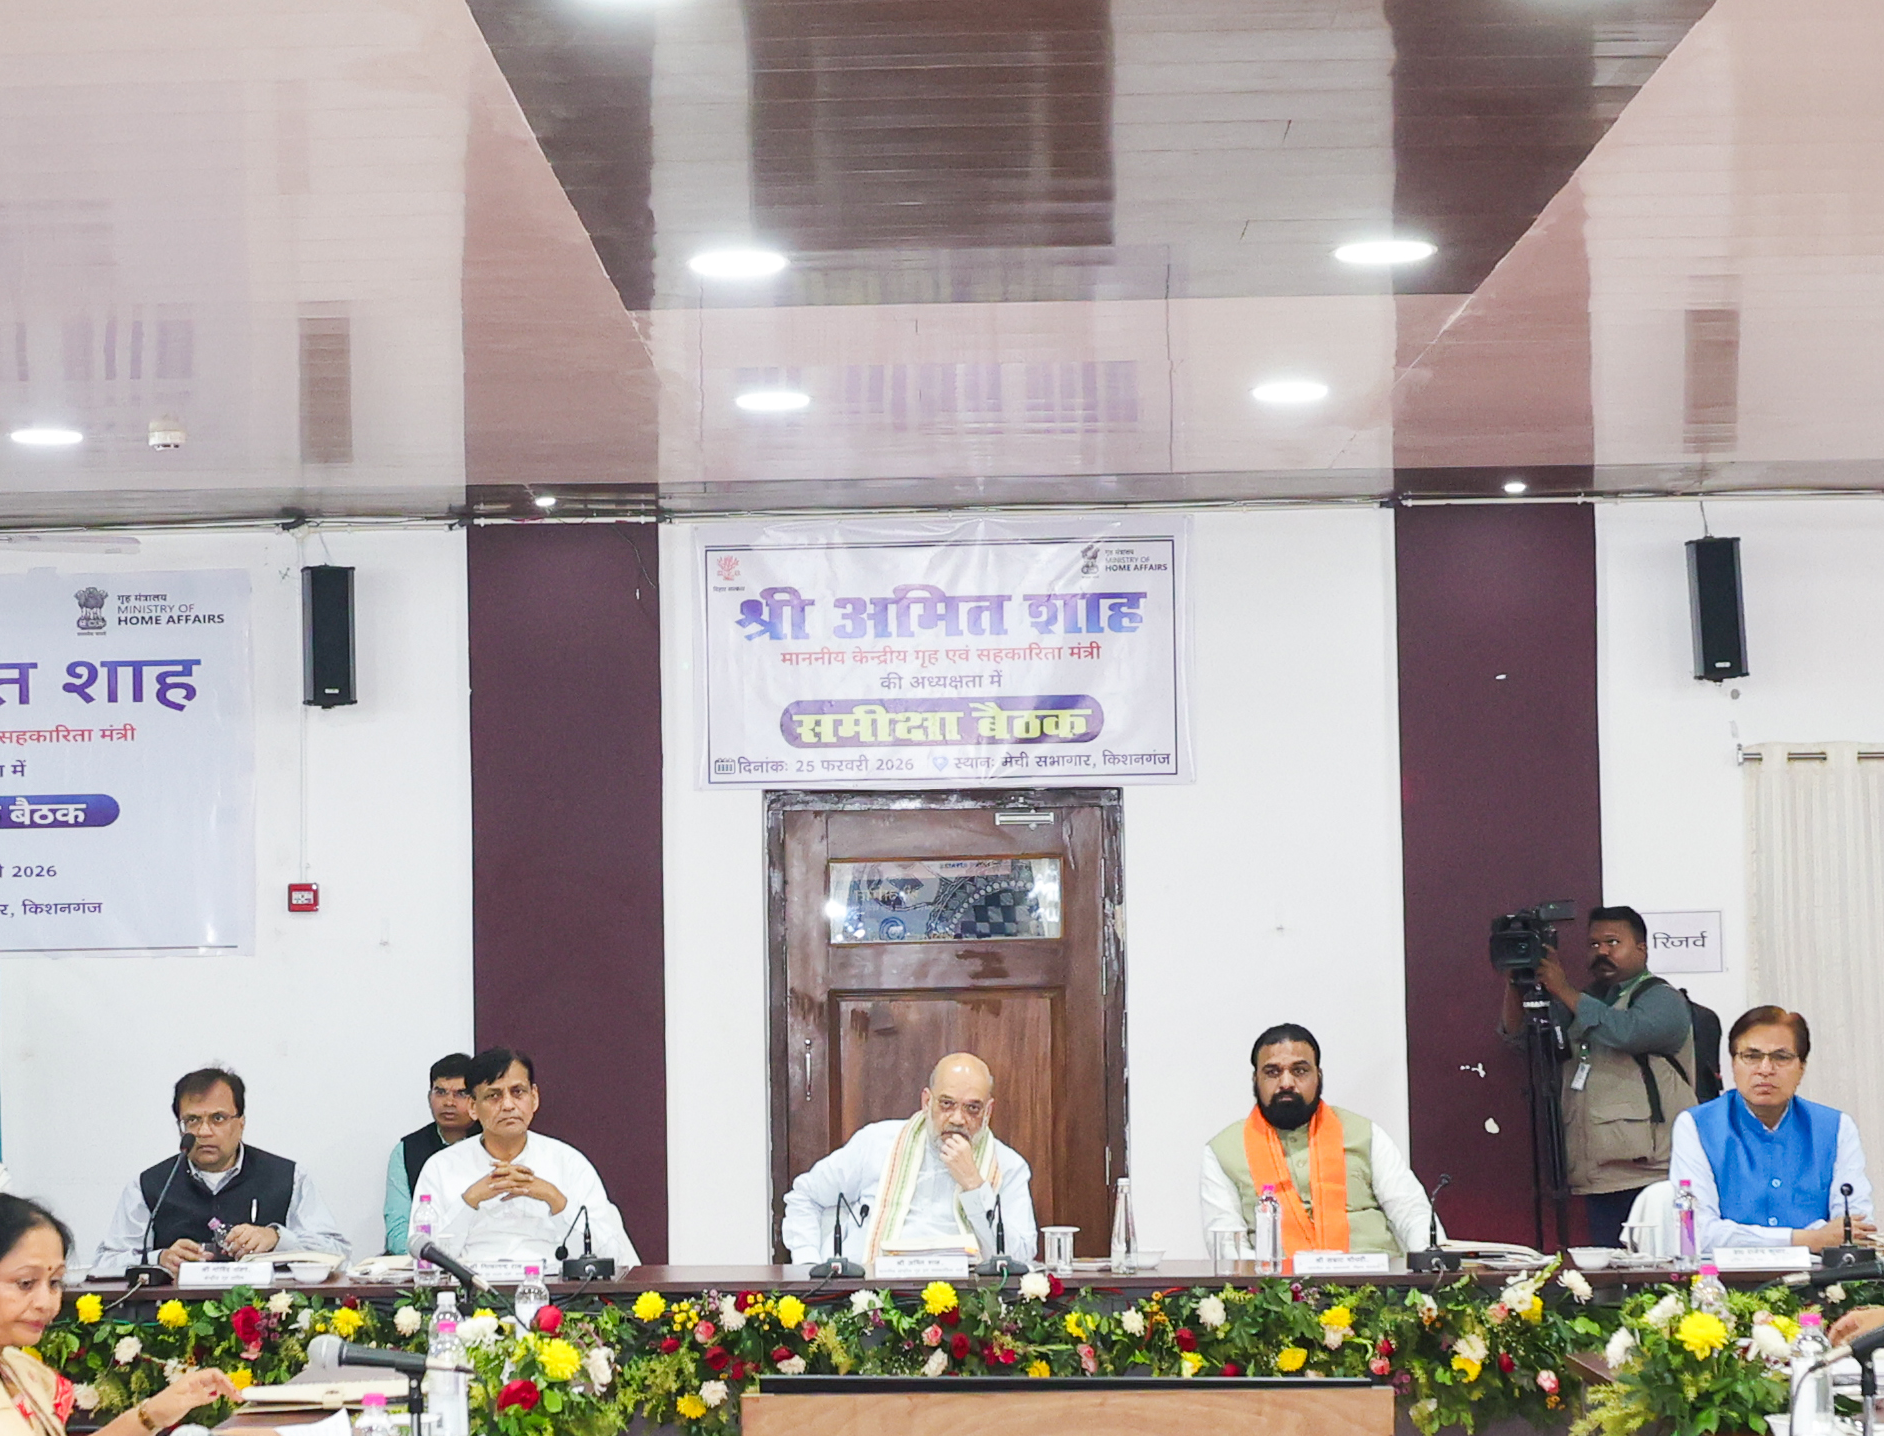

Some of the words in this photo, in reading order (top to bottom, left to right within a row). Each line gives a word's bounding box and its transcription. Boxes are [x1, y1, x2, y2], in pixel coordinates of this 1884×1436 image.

[1105, 564, 1131, 572] HOME
[1133, 563, 1168, 571] AFFAIRS
[118, 604, 174, 614] MINISTRY
[178, 603, 195, 613] OF
[735, 586, 815, 642] श्री
[833, 584, 1012, 640] अमित
[1023, 591, 1147, 634] शाह
[118, 616, 162, 626] HOME
[166, 614, 225, 625] AFFAIRS
[780, 646, 846, 666] माननीय
[852, 645, 908, 665] केन्द्रीय
[914, 650, 939, 668] गृह
[946, 646, 971, 664] एवं
[977, 643, 1063, 664] सहकारिता
[1069, 641, 1102, 660] मंत्री
[62, 659, 201, 712] शाह
[880, 672, 903, 690] की
[909, 674, 983, 690] अध्यक्षता
[989, 670, 1002, 688] में
[792, 704, 964, 743] समीक्षा
[969, 702, 1092, 740] बैठक
[99, 723, 137, 742] मंत्री
[11, 760, 27, 777] में
[795, 760, 815, 773] 25
[821, 754, 869, 773] फरवरी
[876, 758, 914, 771] 2026
[1001, 752, 1029, 768] मेची
[1035, 754, 1096, 769] सभागार,
[1102, 749, 1171, 767] किशनगंज
[9, 797, 87, 826] बैठक
[12, 865, 57, 878] 2026
[21, 898, 103, 916] किशनगंज
[1652, 930, 1708, 949] रिजर्व
